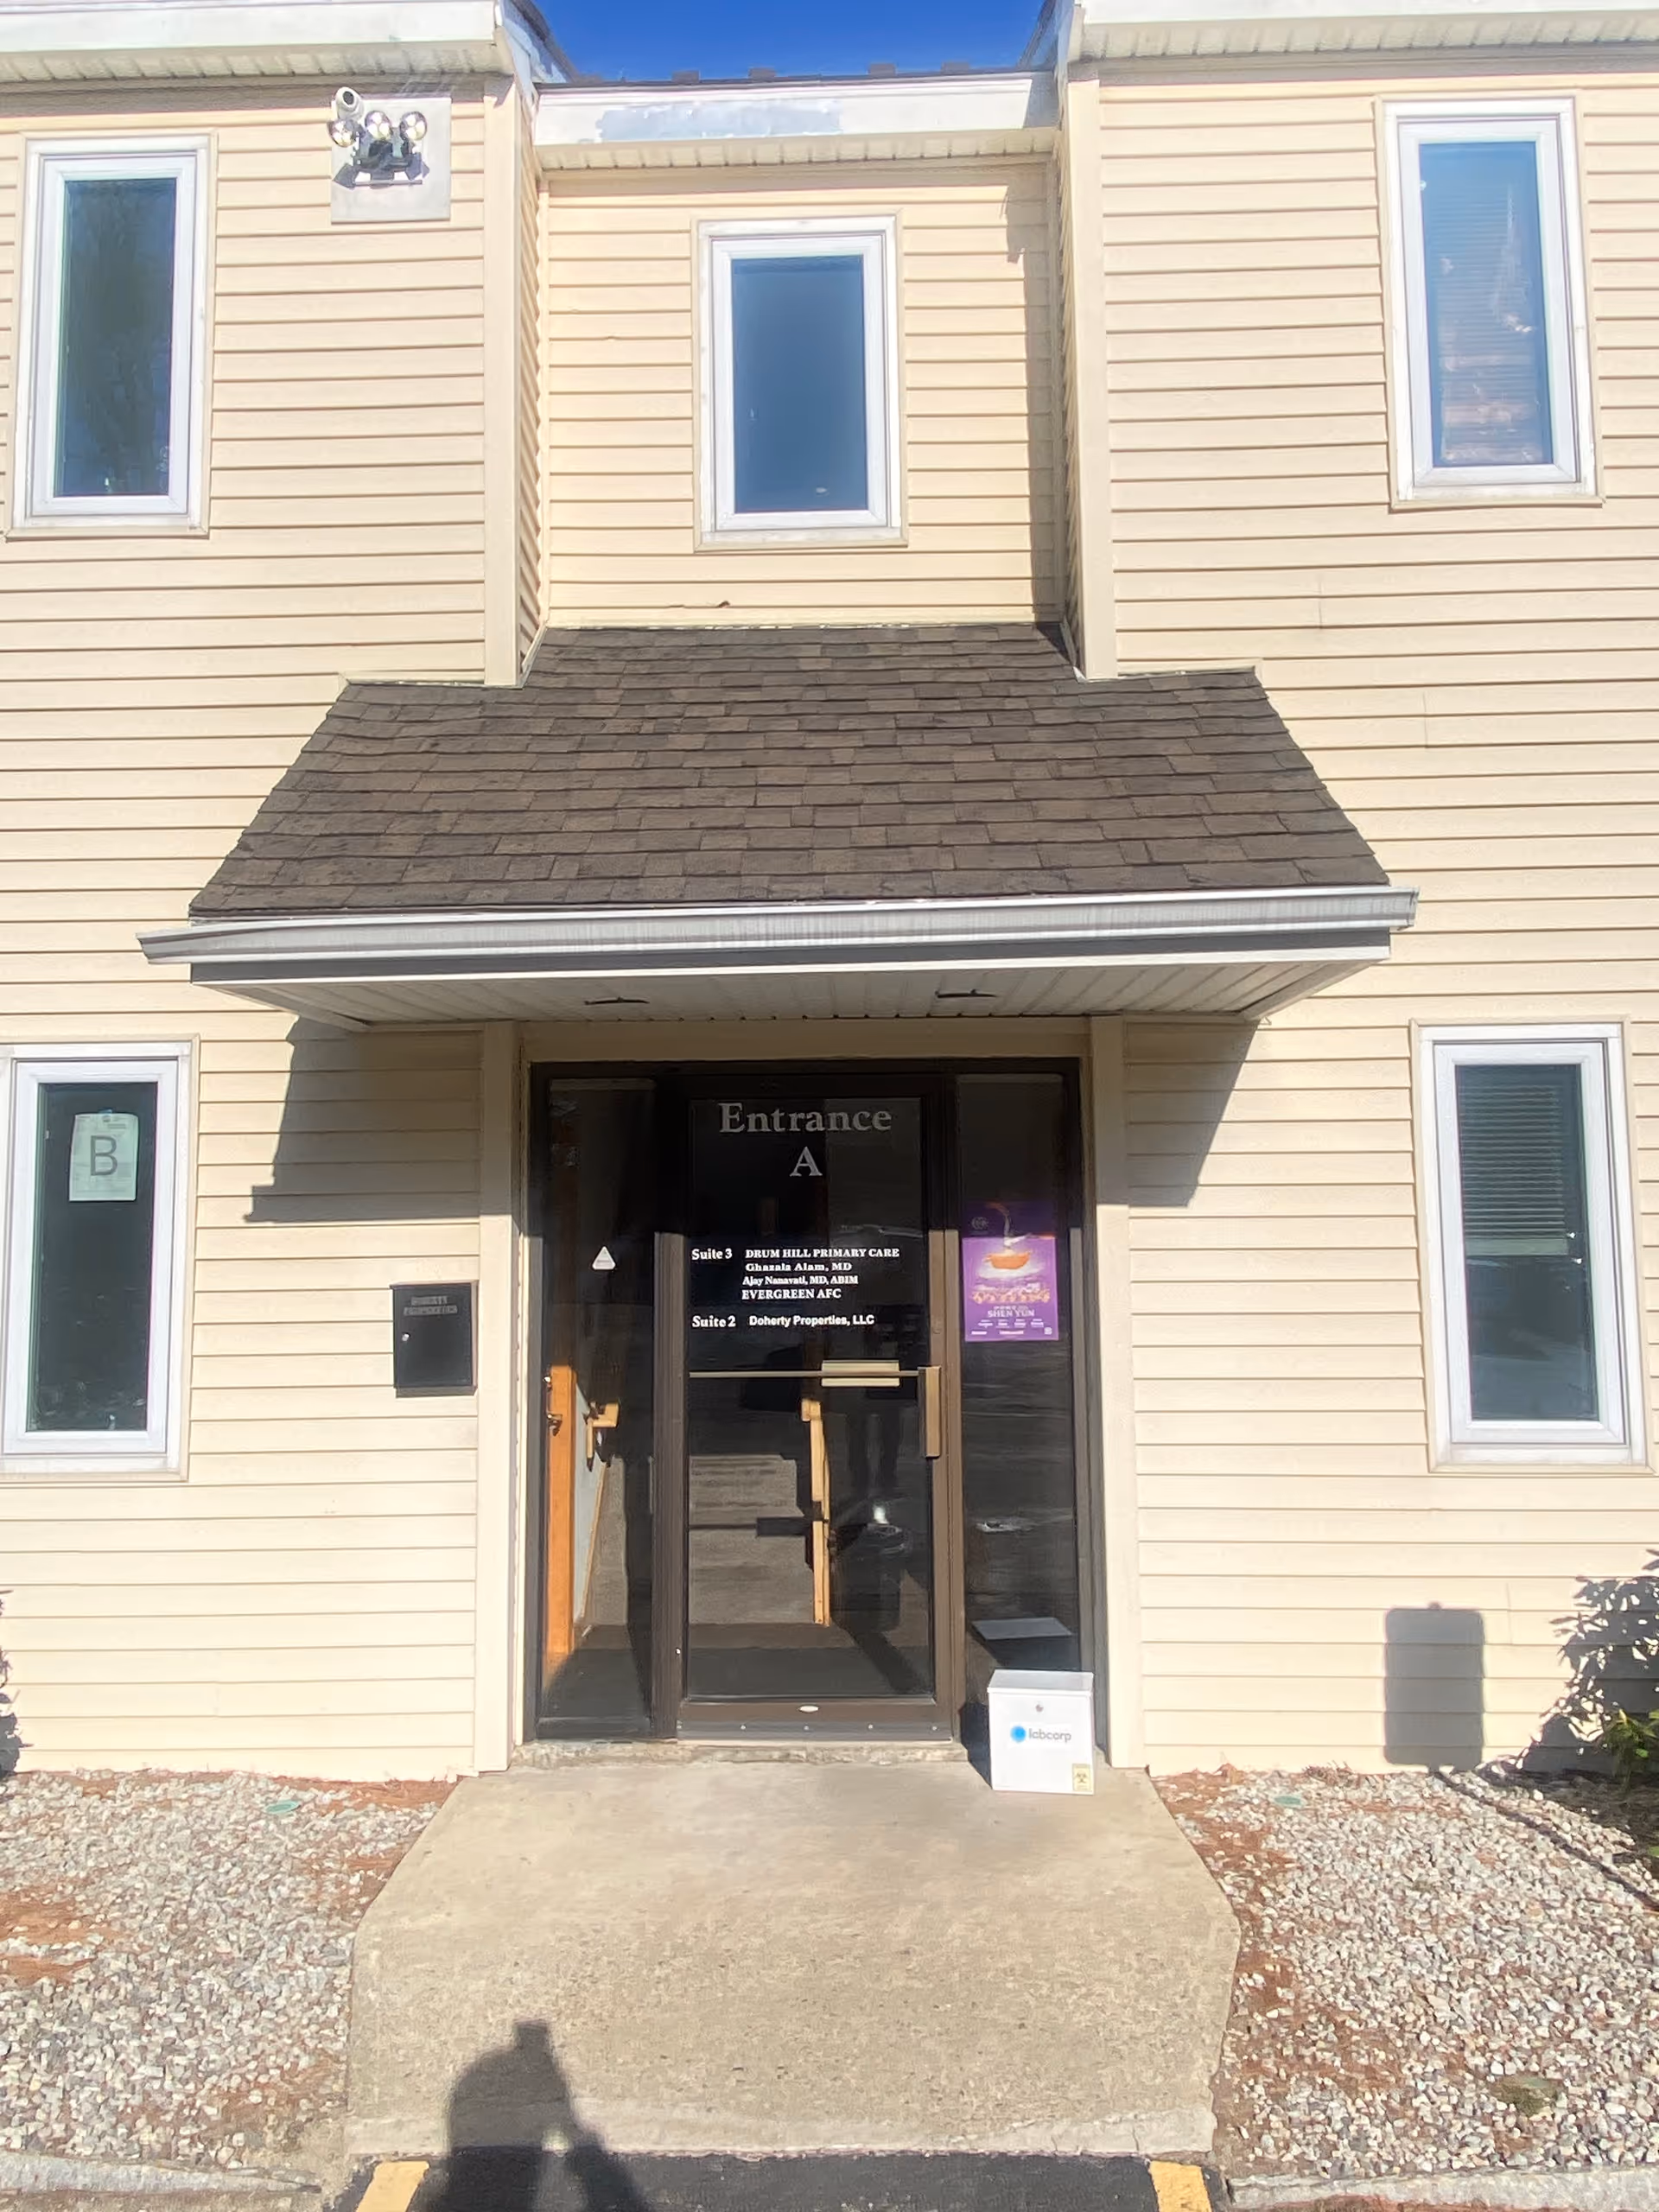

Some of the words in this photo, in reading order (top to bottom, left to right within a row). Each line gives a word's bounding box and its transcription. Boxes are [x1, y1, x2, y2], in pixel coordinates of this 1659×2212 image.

[718, 1103, 893, 1133] Entrance
[90, 1135, 118, 1176] B
[789, 1146, 823, 1177] A
[691, 1249, 723, 1260] Suite
[725, 1248, 733, 1259] 3
[745, 1249, 780, 1258] DRUM
[782, 1249, 811, 1258] HILL
[812, 1249, 867, 1258] PRIMARY
[868, 1248, 900, 1257] CARE
[745, 1262, 791, 1272] Ghazala
[831, 1262, 853, 1271] MD
[742, 1276, 764, 1287] Ajay
[809, 1275, 830, 1285] MD,
[830, 1275, 859, 1285] ABIM
[741, 1289, 815, 1300] EVERGREEN
[817, 1288, 842, 1299] AFC
[987, 1309, 1014, 1318] SHEN
[1015, 1309, 1035, 1318] YUN
[691, 1315, 727, 1327] Suite
[728, 1315, 736, 1327] 2
[749, 1315, 791, 1328] Doherty
[793, 1315, 850, 1327] Properties,
[852, 1314, 875, 1325] LLC
[1028, 1728, 1071, 1743] labcorp
